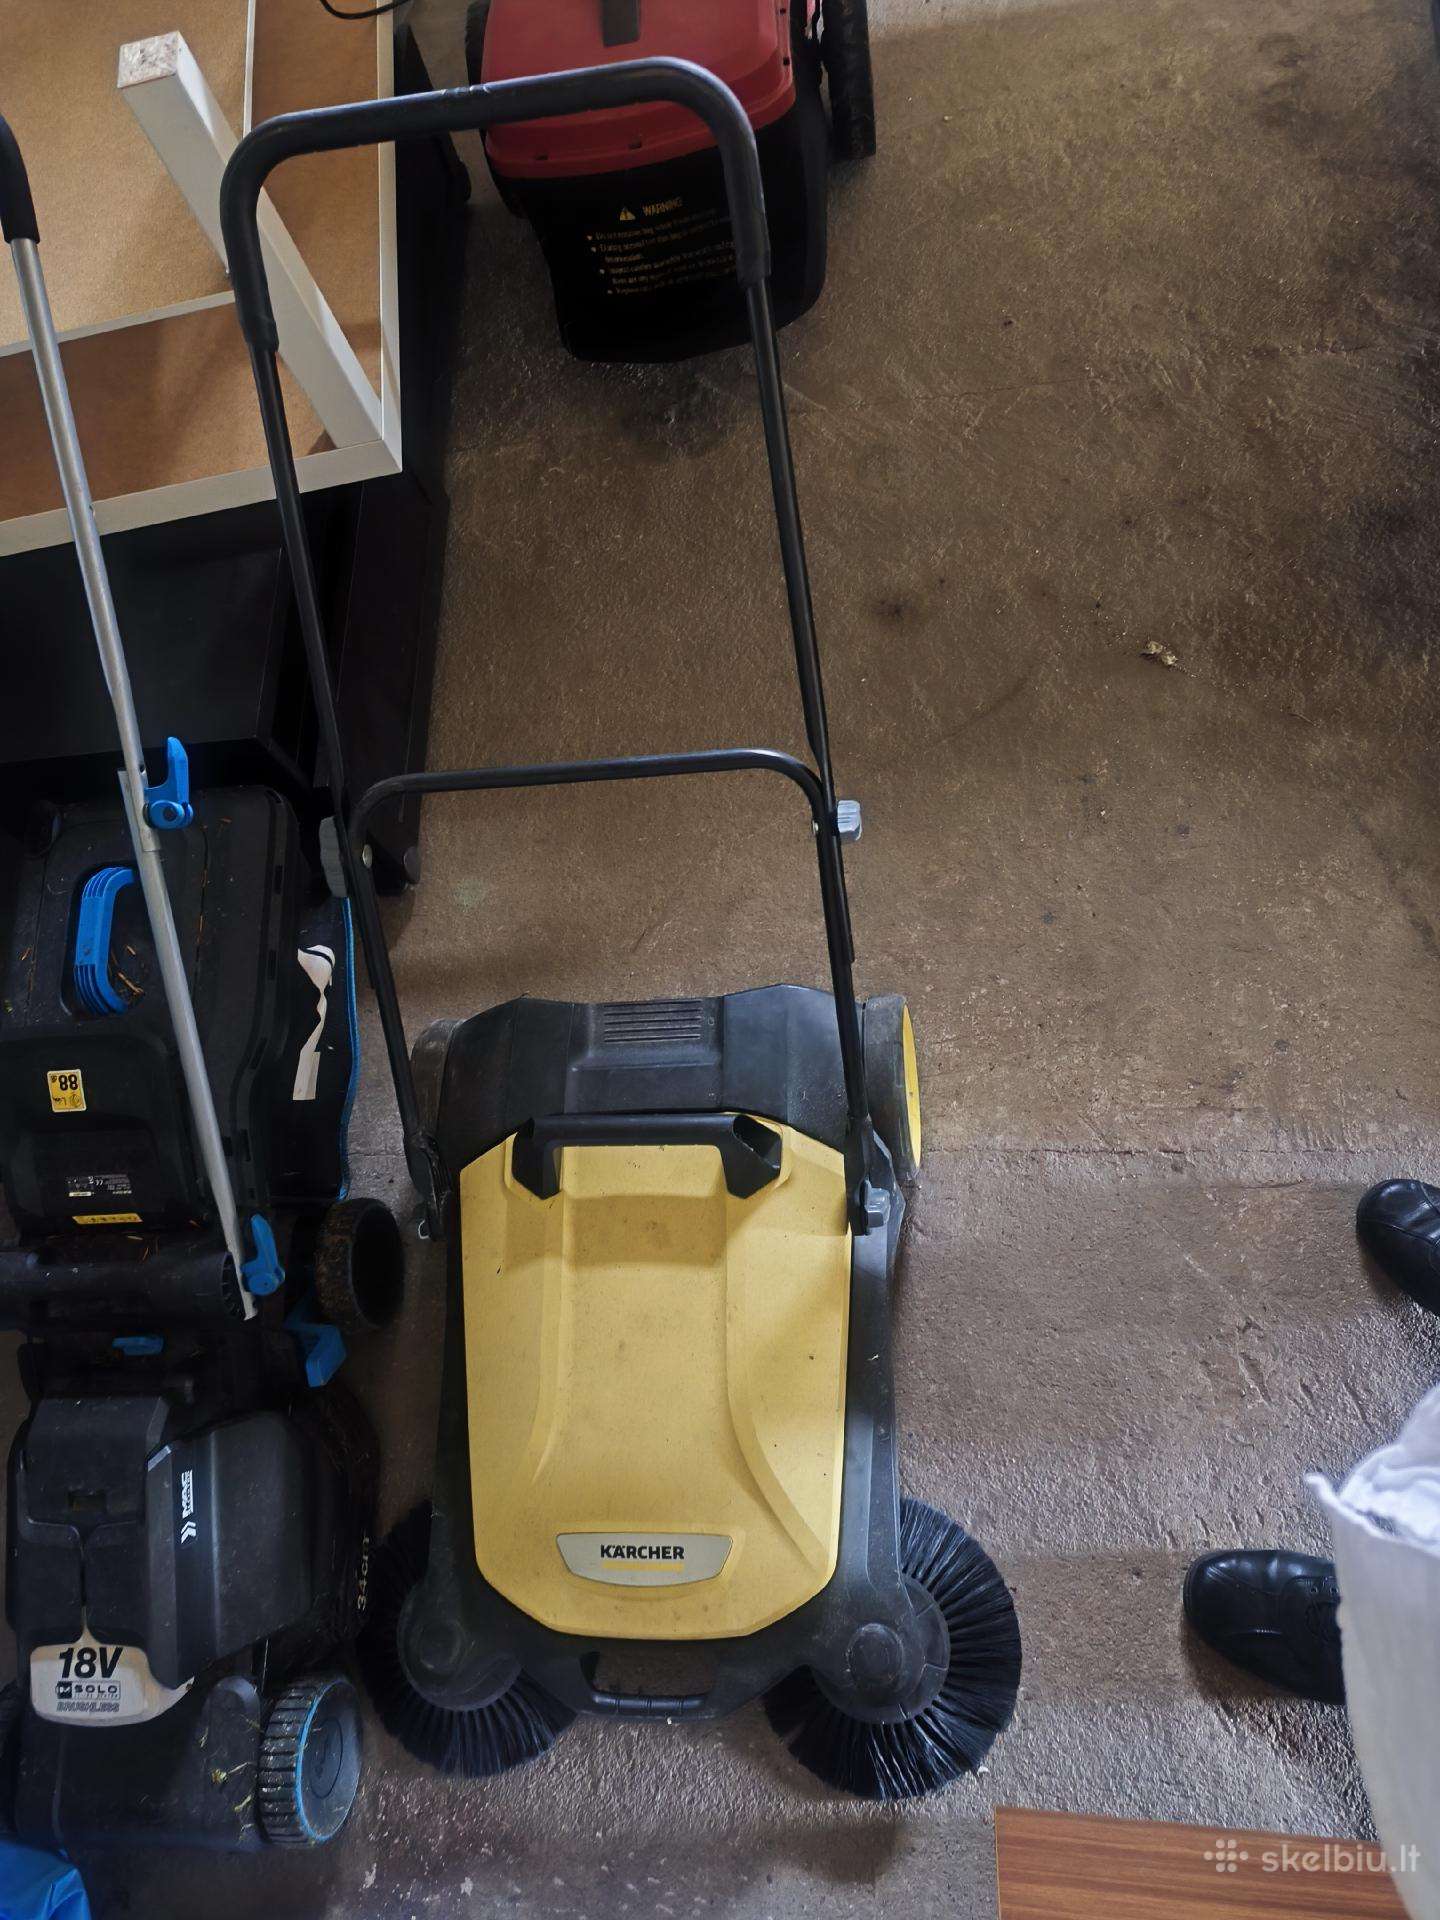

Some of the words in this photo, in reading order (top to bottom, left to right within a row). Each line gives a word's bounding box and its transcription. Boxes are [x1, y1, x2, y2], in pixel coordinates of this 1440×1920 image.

[58, 1074, 78, 1091] 88
[600, 1544, 685, 1560] KÄRCHER
[58, 1646, 123, 1679] 18V
[74, 1684, 118, 1694] SOLO
[56, 1701, 120, 1713] BRUSHLESS
